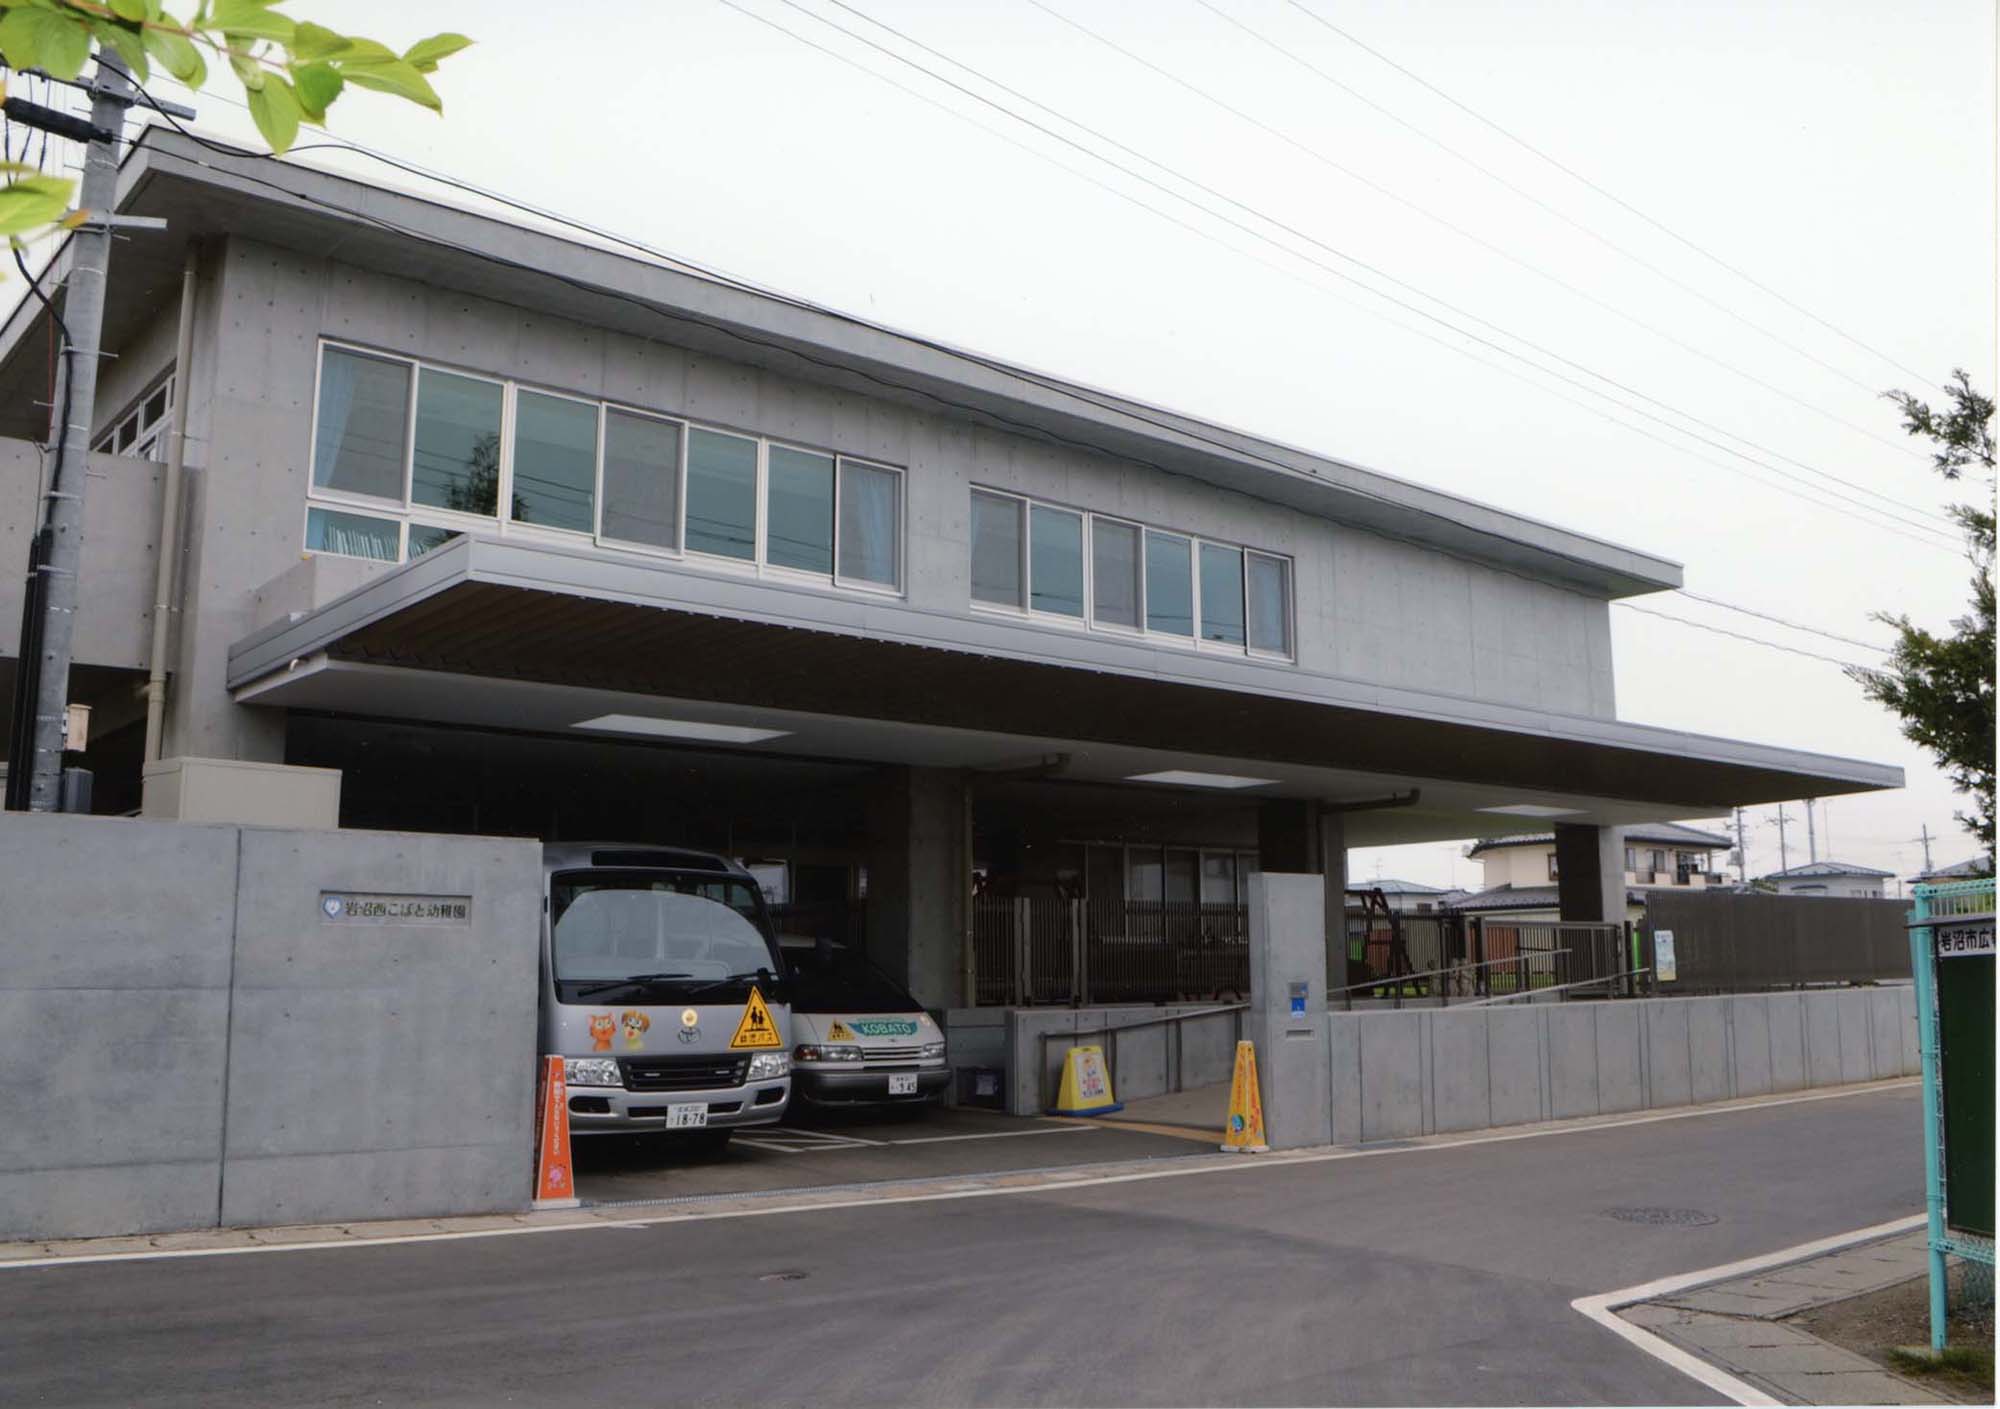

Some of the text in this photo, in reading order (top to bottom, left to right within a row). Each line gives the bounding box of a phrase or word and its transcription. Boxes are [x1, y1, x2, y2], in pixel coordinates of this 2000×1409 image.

[345, 902, 466, 919] 岩沼西こばと幼稚園
[862, 1023, 912, 1034] KOBATO
